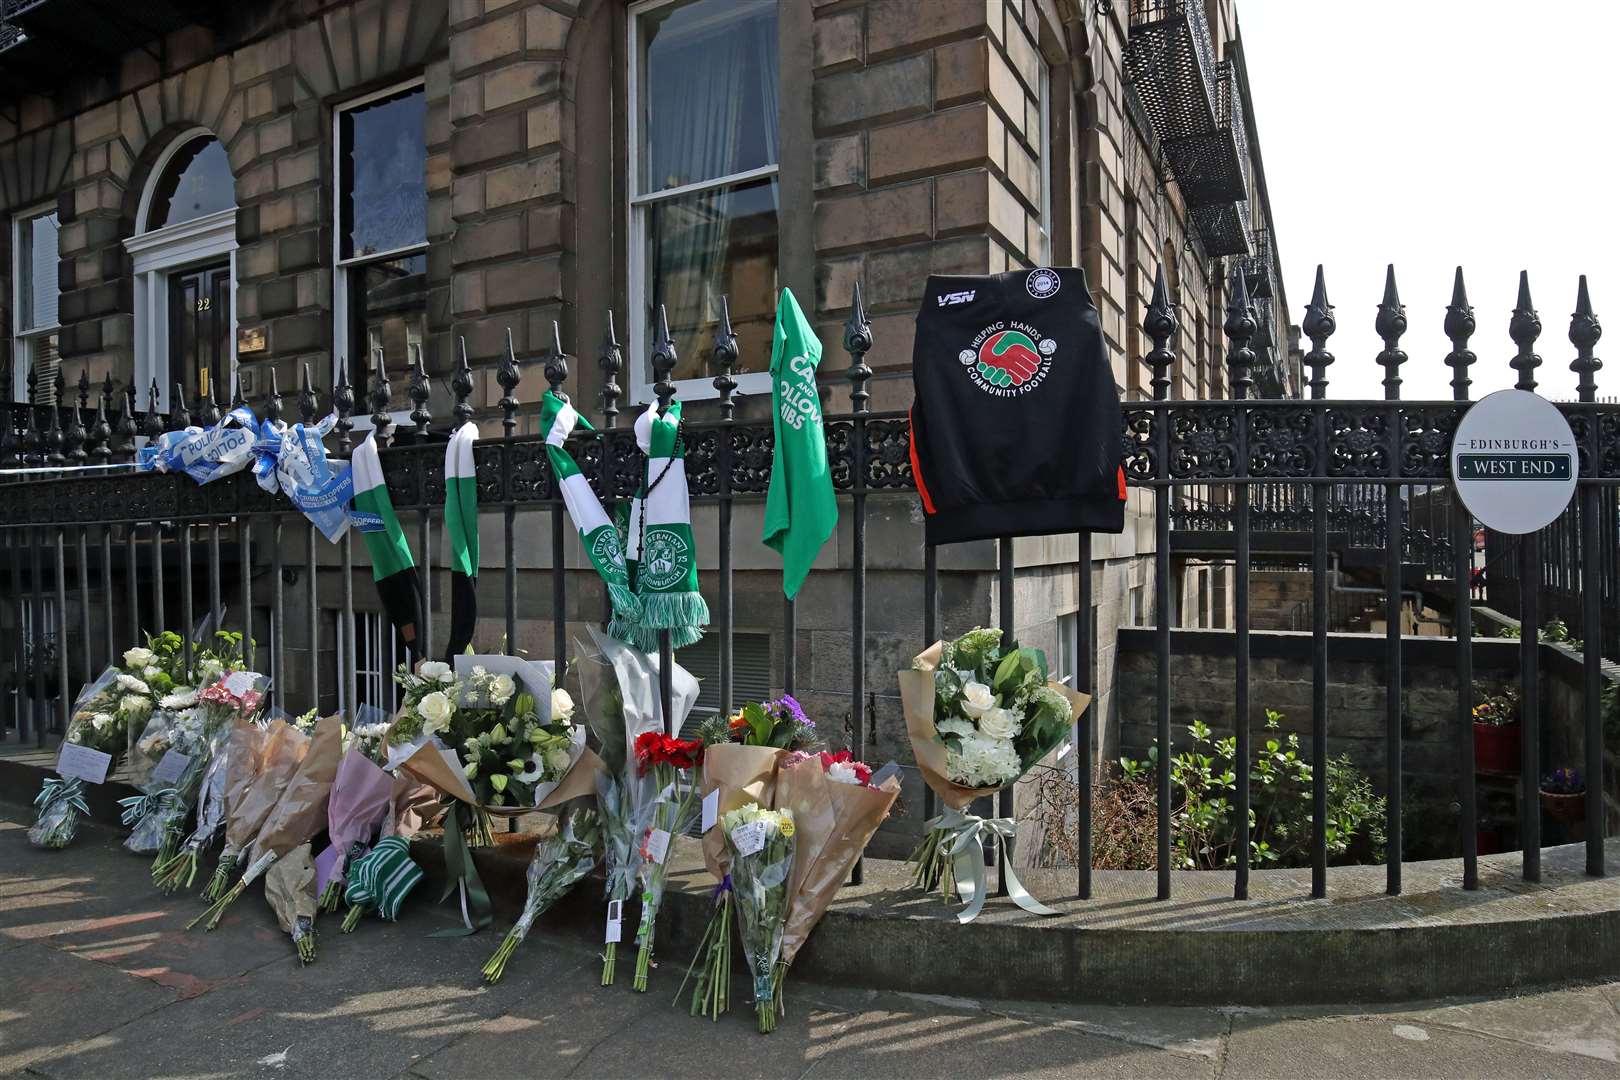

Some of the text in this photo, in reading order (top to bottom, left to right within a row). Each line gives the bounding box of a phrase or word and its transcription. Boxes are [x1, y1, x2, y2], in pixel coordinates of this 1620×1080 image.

[197, 298, 211, 312] 22
[971, 321, 1042, 349] HELPING HANDS
[967, 354, 1052, 397] COMMUNITY FOOTBALL
[796, 382, 814, 397] AND
[1470, 439, 1559, 450] EDINBURGH'S
[1473, 460, 1555, 475] WEST END
[676, 555, 688, 564] 75
